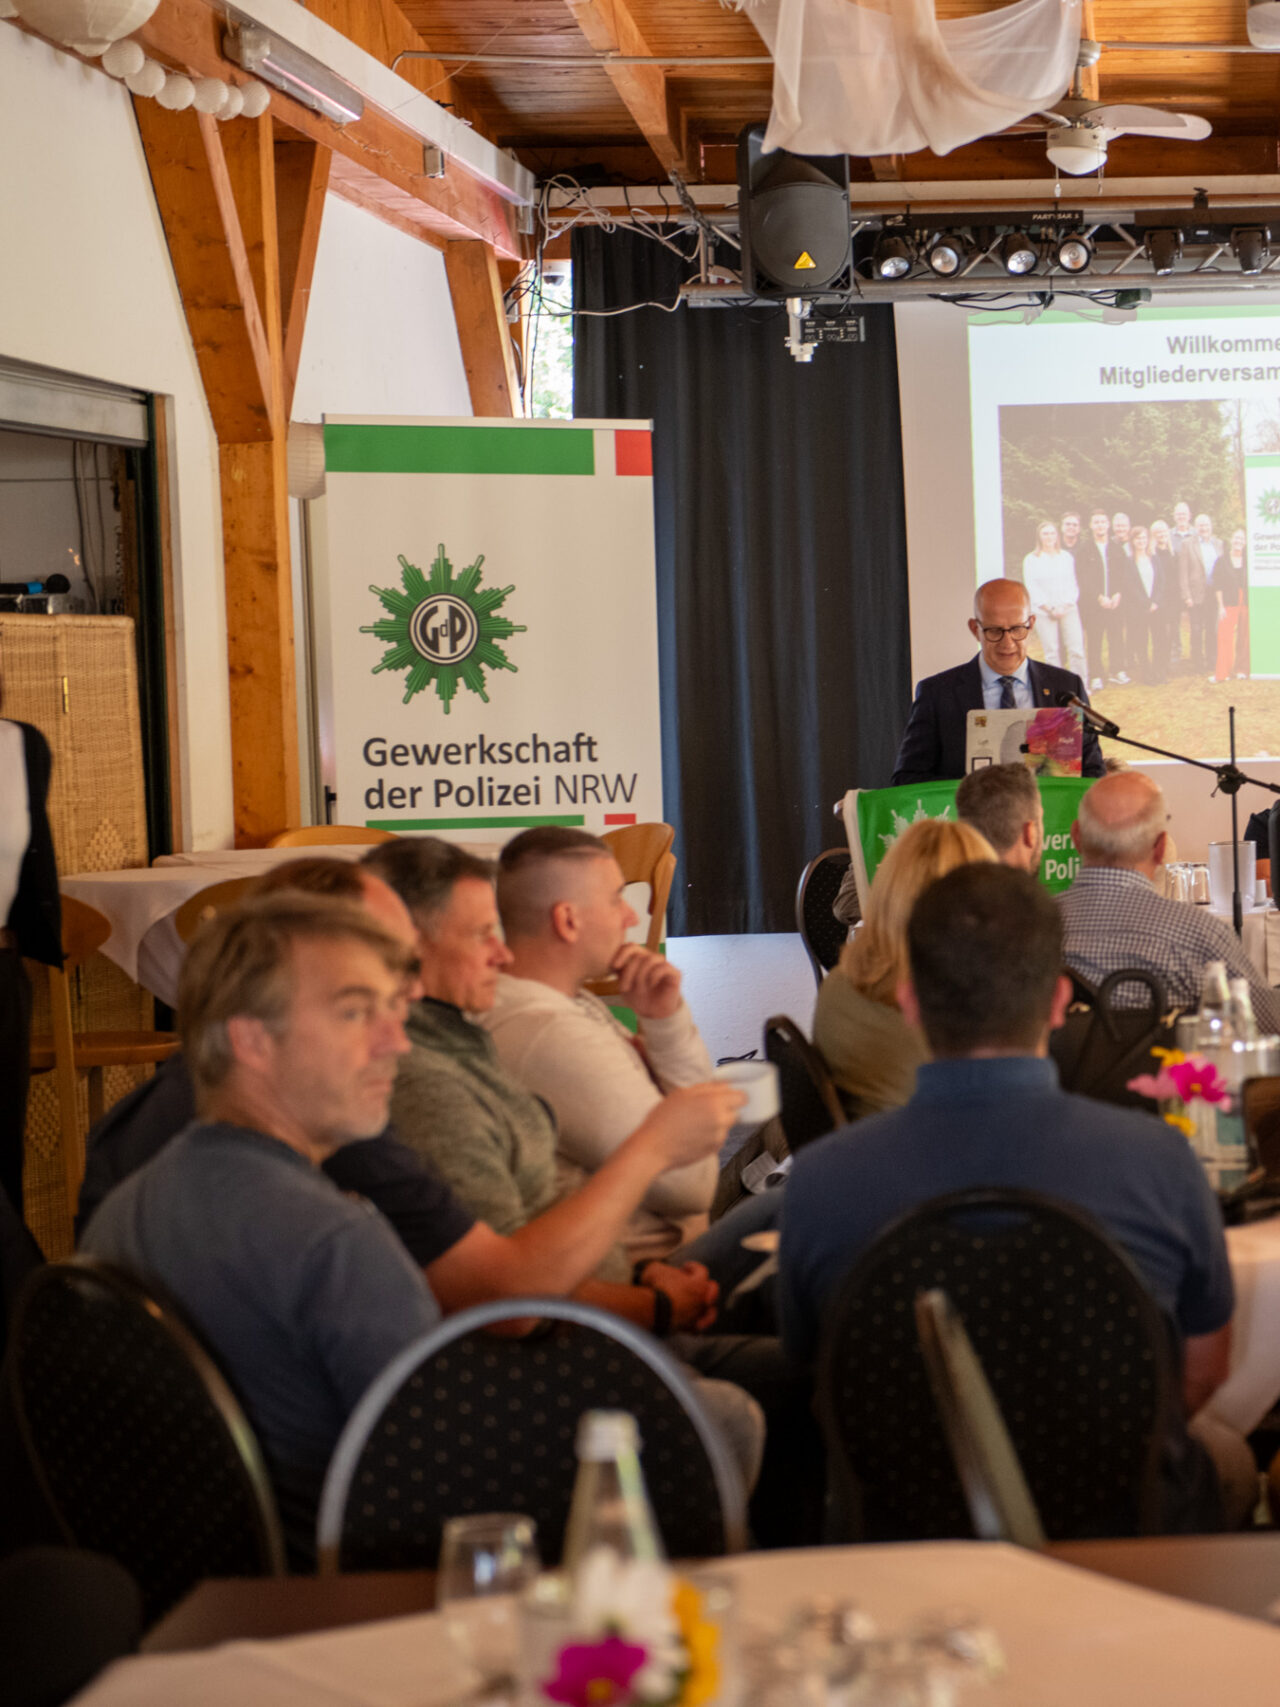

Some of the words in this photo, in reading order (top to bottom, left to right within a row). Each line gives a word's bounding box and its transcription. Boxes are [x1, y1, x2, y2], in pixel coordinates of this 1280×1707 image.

[362, 732, 598, 767] Gewerkschaft
[364, 778, 423, 810] der
[433, 775, 541, 808] Polizei
[555, 773, 638, 804] NRW
